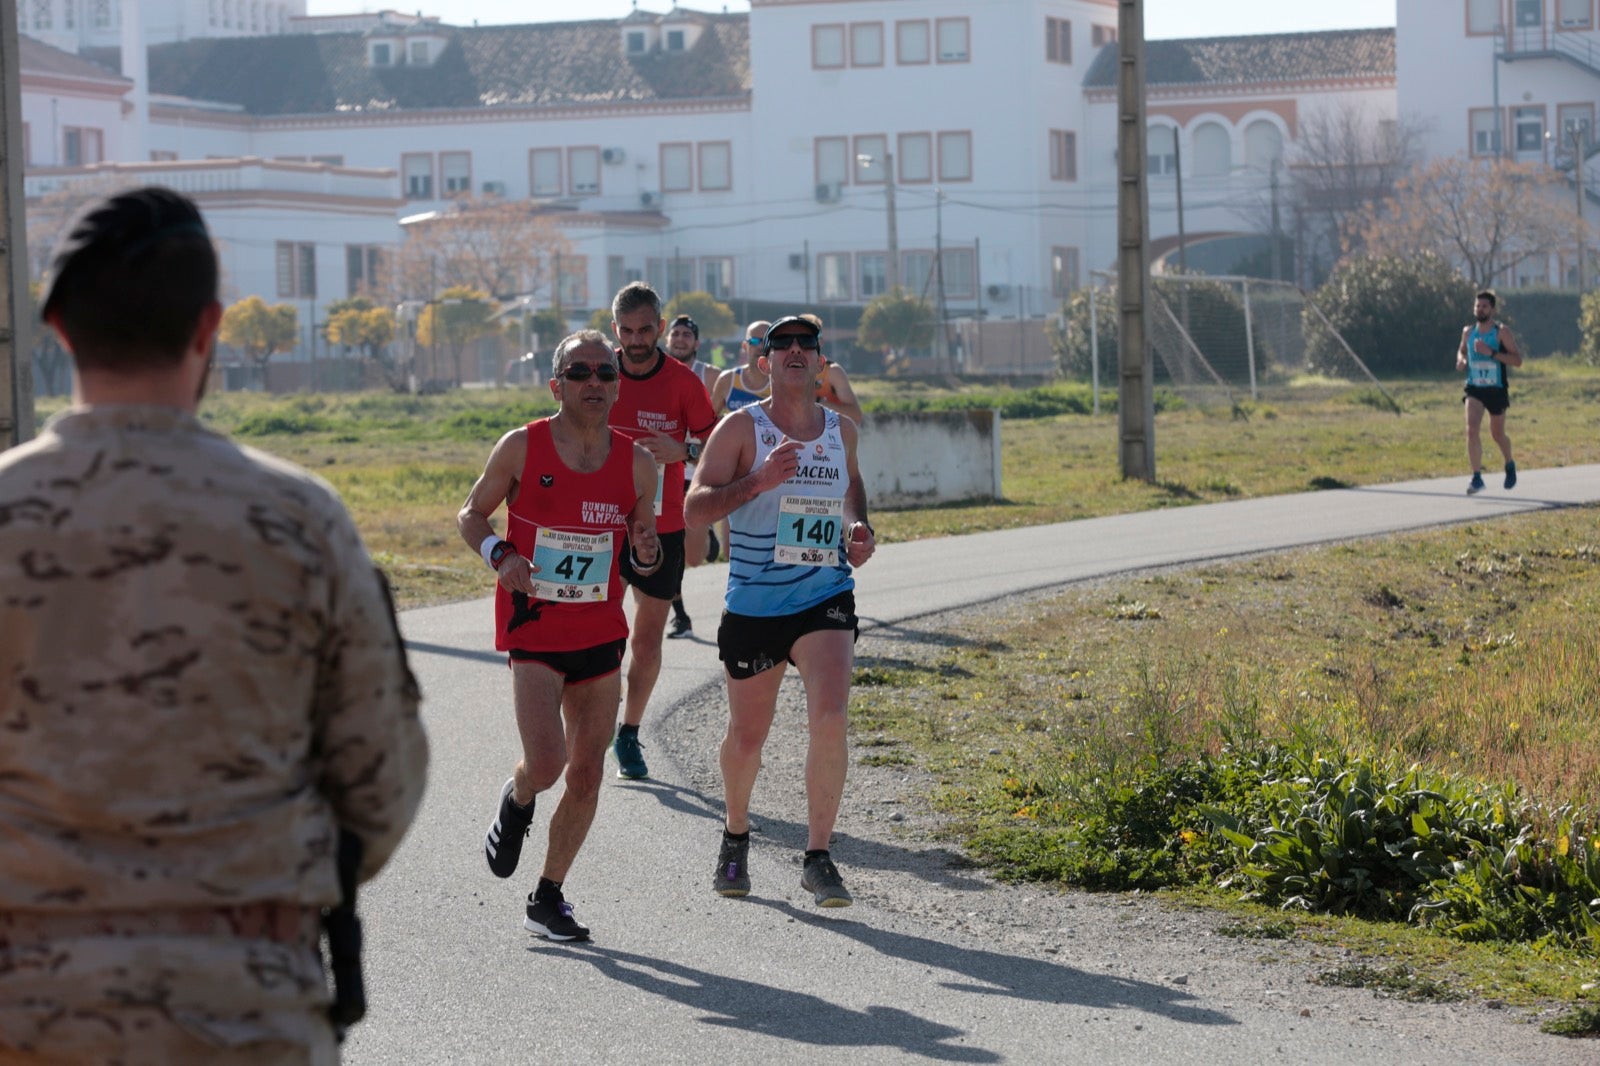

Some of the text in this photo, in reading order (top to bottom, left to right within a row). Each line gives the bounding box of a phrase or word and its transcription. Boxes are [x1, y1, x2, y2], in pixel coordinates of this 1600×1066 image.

[637, 410, 667, 420] RUNNING
[637, 418, 678, 430] VAMPIROS
[796, 466, 839, 480] RACENA
[582, 501, 620, 513] RUNNING
[792, 518, 835, 544] 140
[557, 533, 571, 542] GRAN
[572, 535, 590, 544] PREMIO
[555, 554, 594, 581] 47
